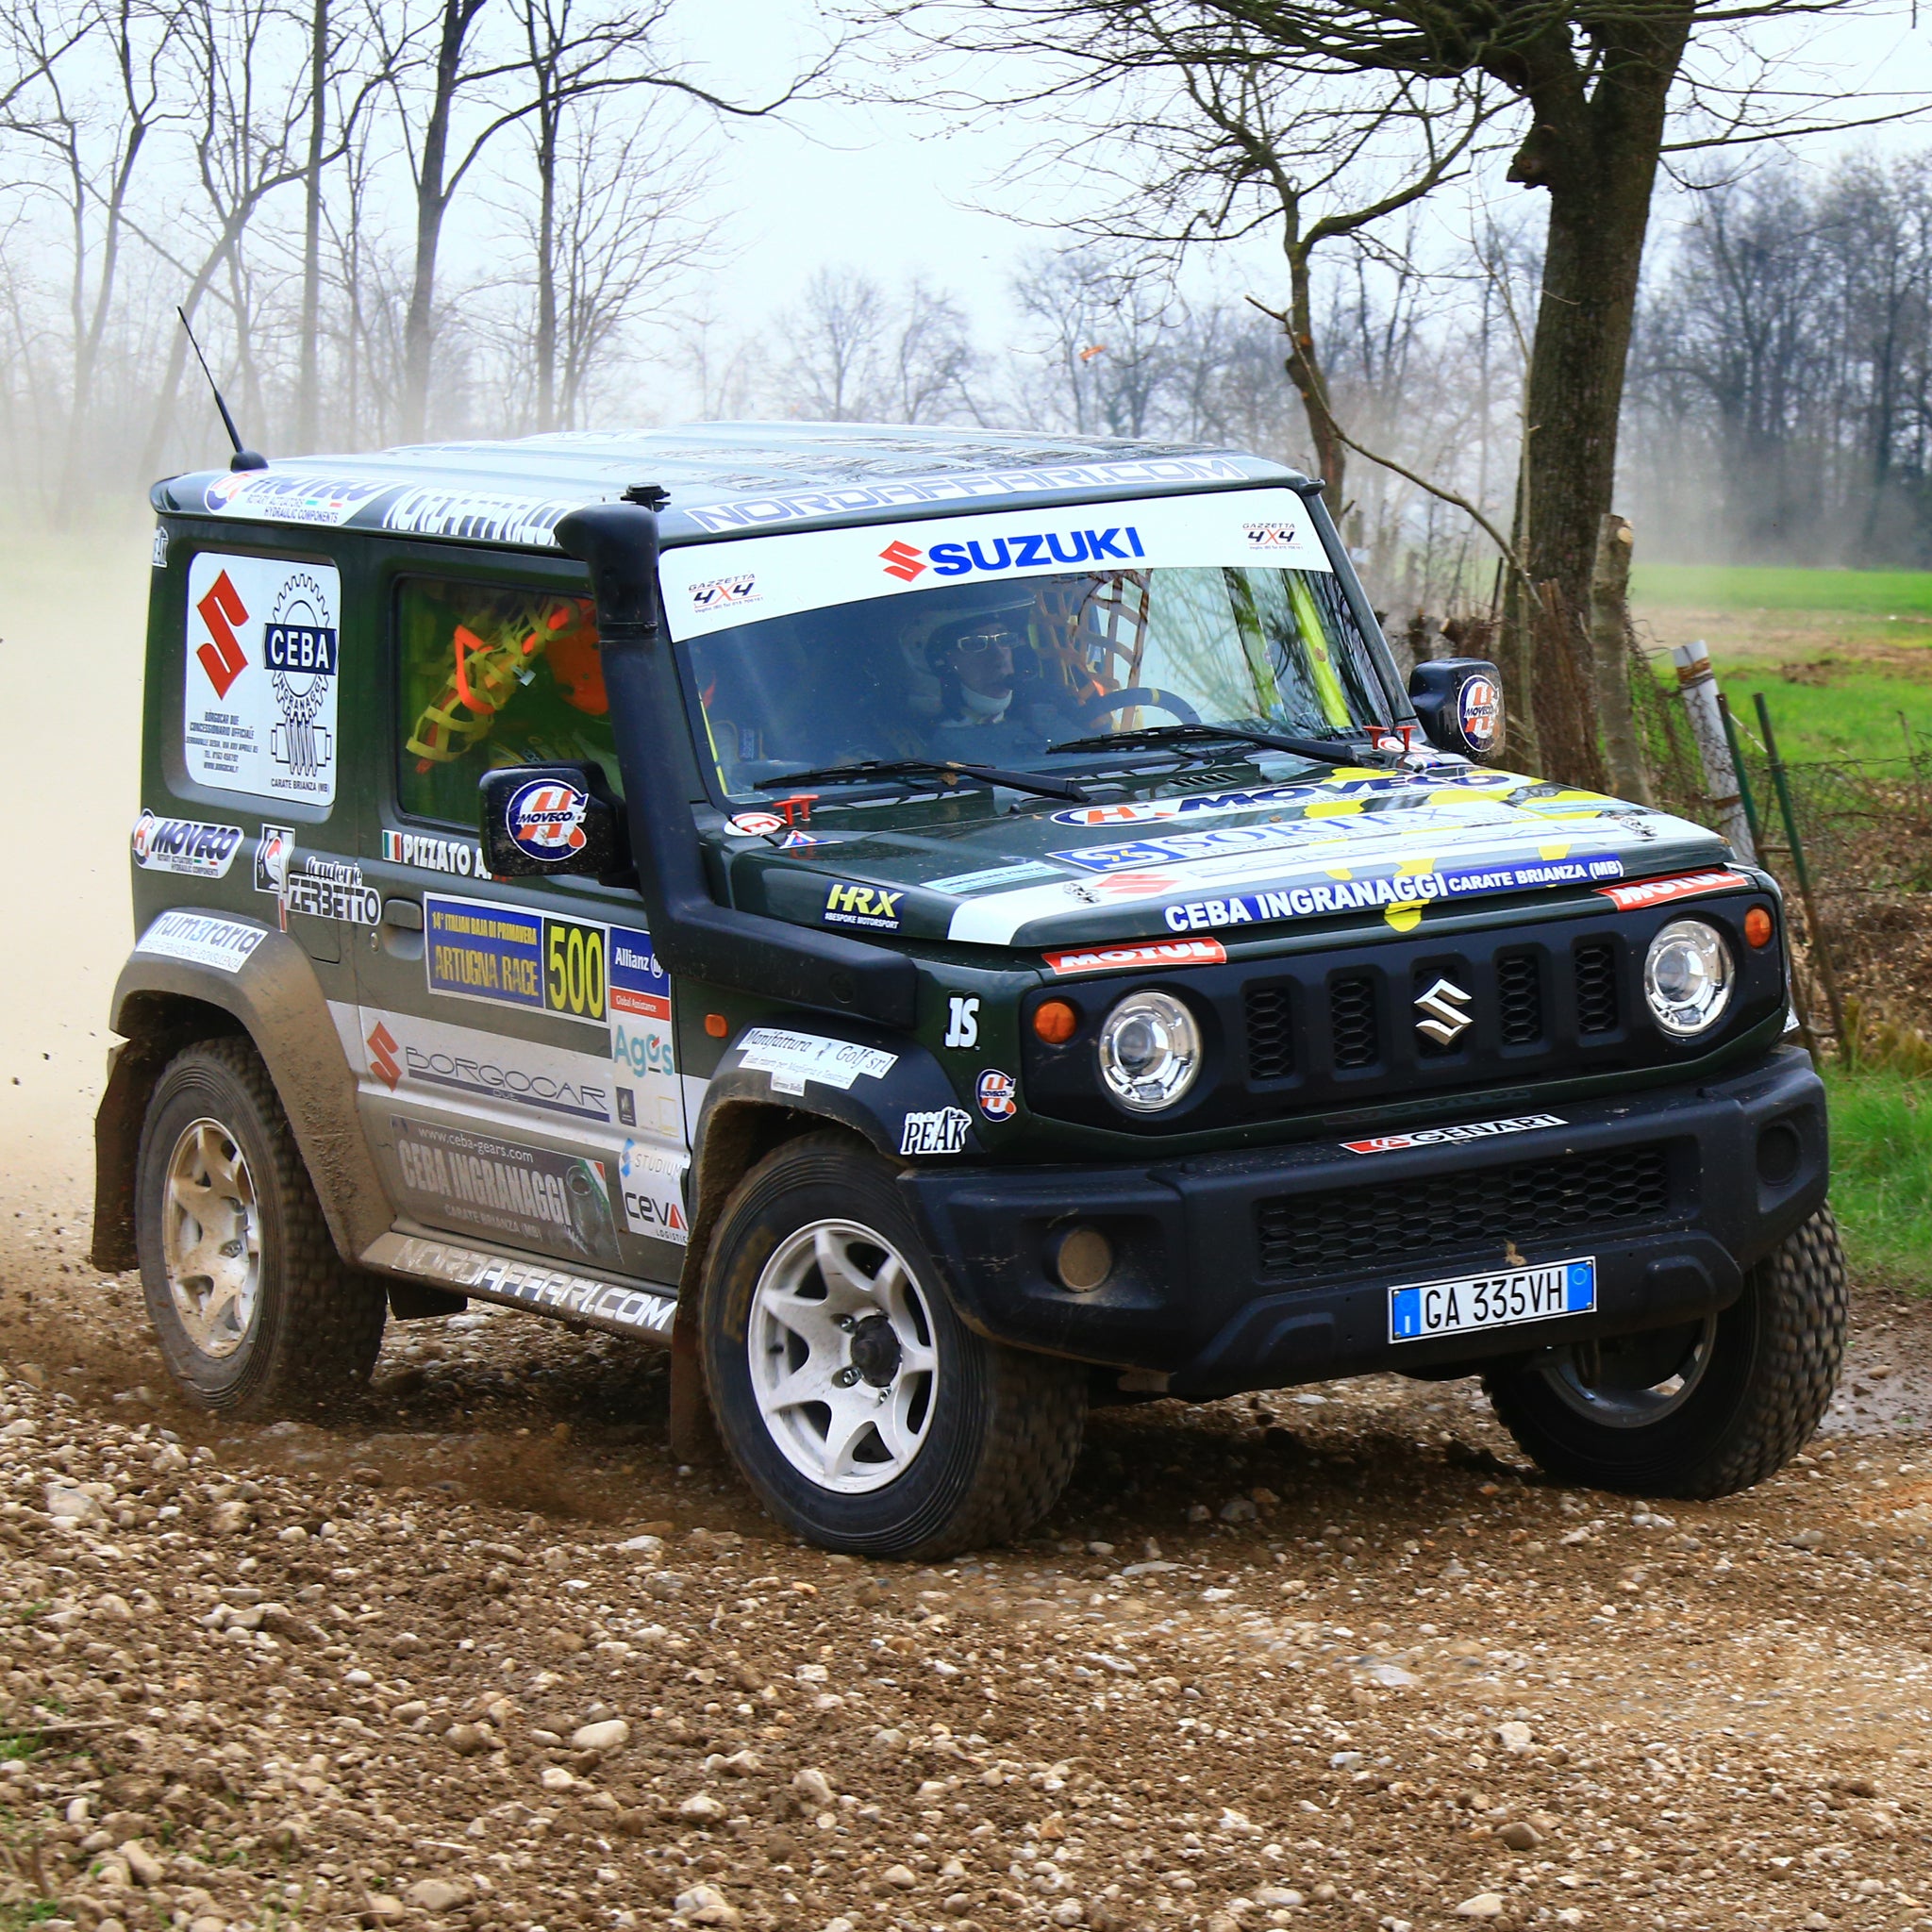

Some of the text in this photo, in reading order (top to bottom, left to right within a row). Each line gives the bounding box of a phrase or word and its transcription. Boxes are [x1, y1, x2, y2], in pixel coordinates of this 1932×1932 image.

[691, 458, 1246, 531] NORDAFFARI.COM
[928, 526, 1145, 576] SUZUKI
[689, 574, 755, 591] GAZZETTA
[272, 629, 329, 669] CEBA
[1465, 706, 1493, 717] MOVECO
[271, 778, 291, 789] CARATE
[293, 780, 316, 791] BRIANZA
[1178, 775, 1510, 812] MOVECO
[519, 811, 572, 824] MOVECO
[1161, 808, 1471, 850] SORTEX
[151, 821, 241, 860] MOVECO
[403, 834, 471, 876] PIZZATO
[289, 878, 380, 924] ZERBETTO
[826, 884, 905, 918] HRX
[1164, 859, 1624, 932] CEBA INGRANAGGI CARATE BRIANZA (MB)
[1615, 872, 1734, 906] MOTUL
[445, 913, 471, 934] ITALIAN
[497, 922, 538, 946] PRIMAVERA
[857, 916, 899, 929] MOTORSPORT
[436, 945, 539, 996] ARTUGNA RACE
[549, 924, 604, 1019] 500
[614, 946, 650, 972] Allianz
[1060, 942, 1217, 968] MOTUL
[614, 1024, 674, 1077] Agos
[741, 1030, 894, 1073] Manifattura Golf srl
[406, 1046, 608, 1110] BORGOCAR
[492, 1090, 519, 1102] DUE
[418, 1127, 534, 1163] www.ceba-gears.com
[905, 1110, 970, 1151] PEAK
[1411, 1115, 1558, 1142] GENART
[398, 1140, 572, 1226] CEBA INGRANAGGI
[635, 1153, 683, 1177] STUDIUM
[391, 1239, 677, 1331] NORDAFFARI.COM
[1425, 1287, 1460, 1329] GA
[1473, 1271, 1562, 1322] 335VH
